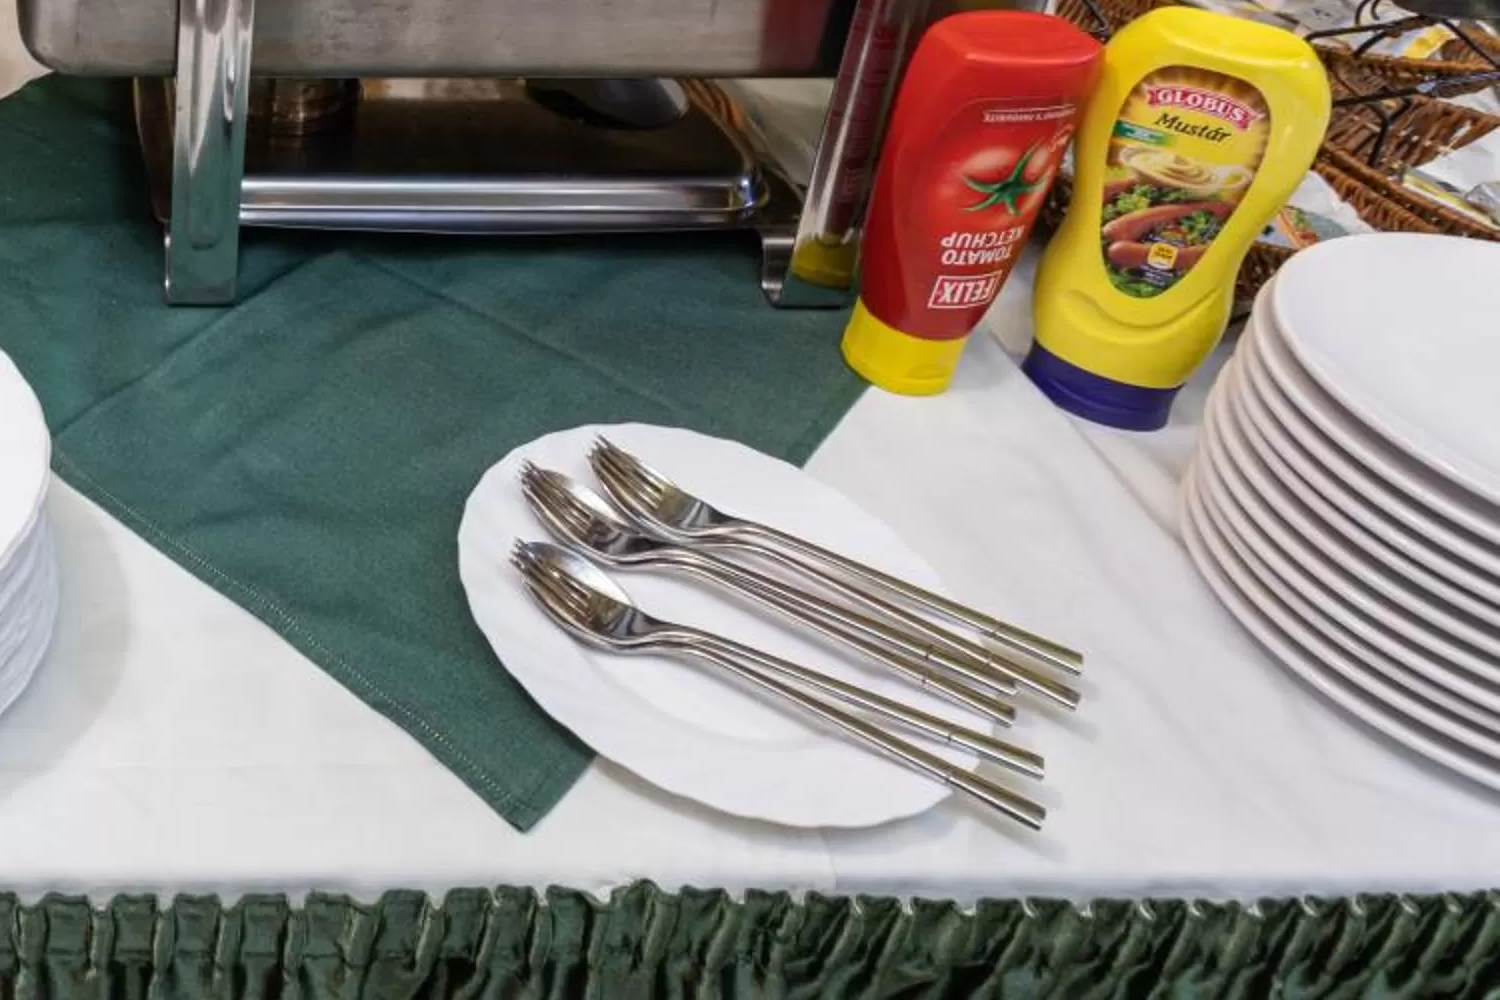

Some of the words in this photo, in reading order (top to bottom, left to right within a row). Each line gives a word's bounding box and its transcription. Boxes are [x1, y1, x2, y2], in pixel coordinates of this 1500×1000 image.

[1157, 87, 1245, 121] GLOBUS
[1154, 112, 1231, 143] Mustár
[941, 225, 1025, 249] KETCHUP
[941, 244, 1012, 265] TOMATO
[937, 277, 995, 303] FELIX
